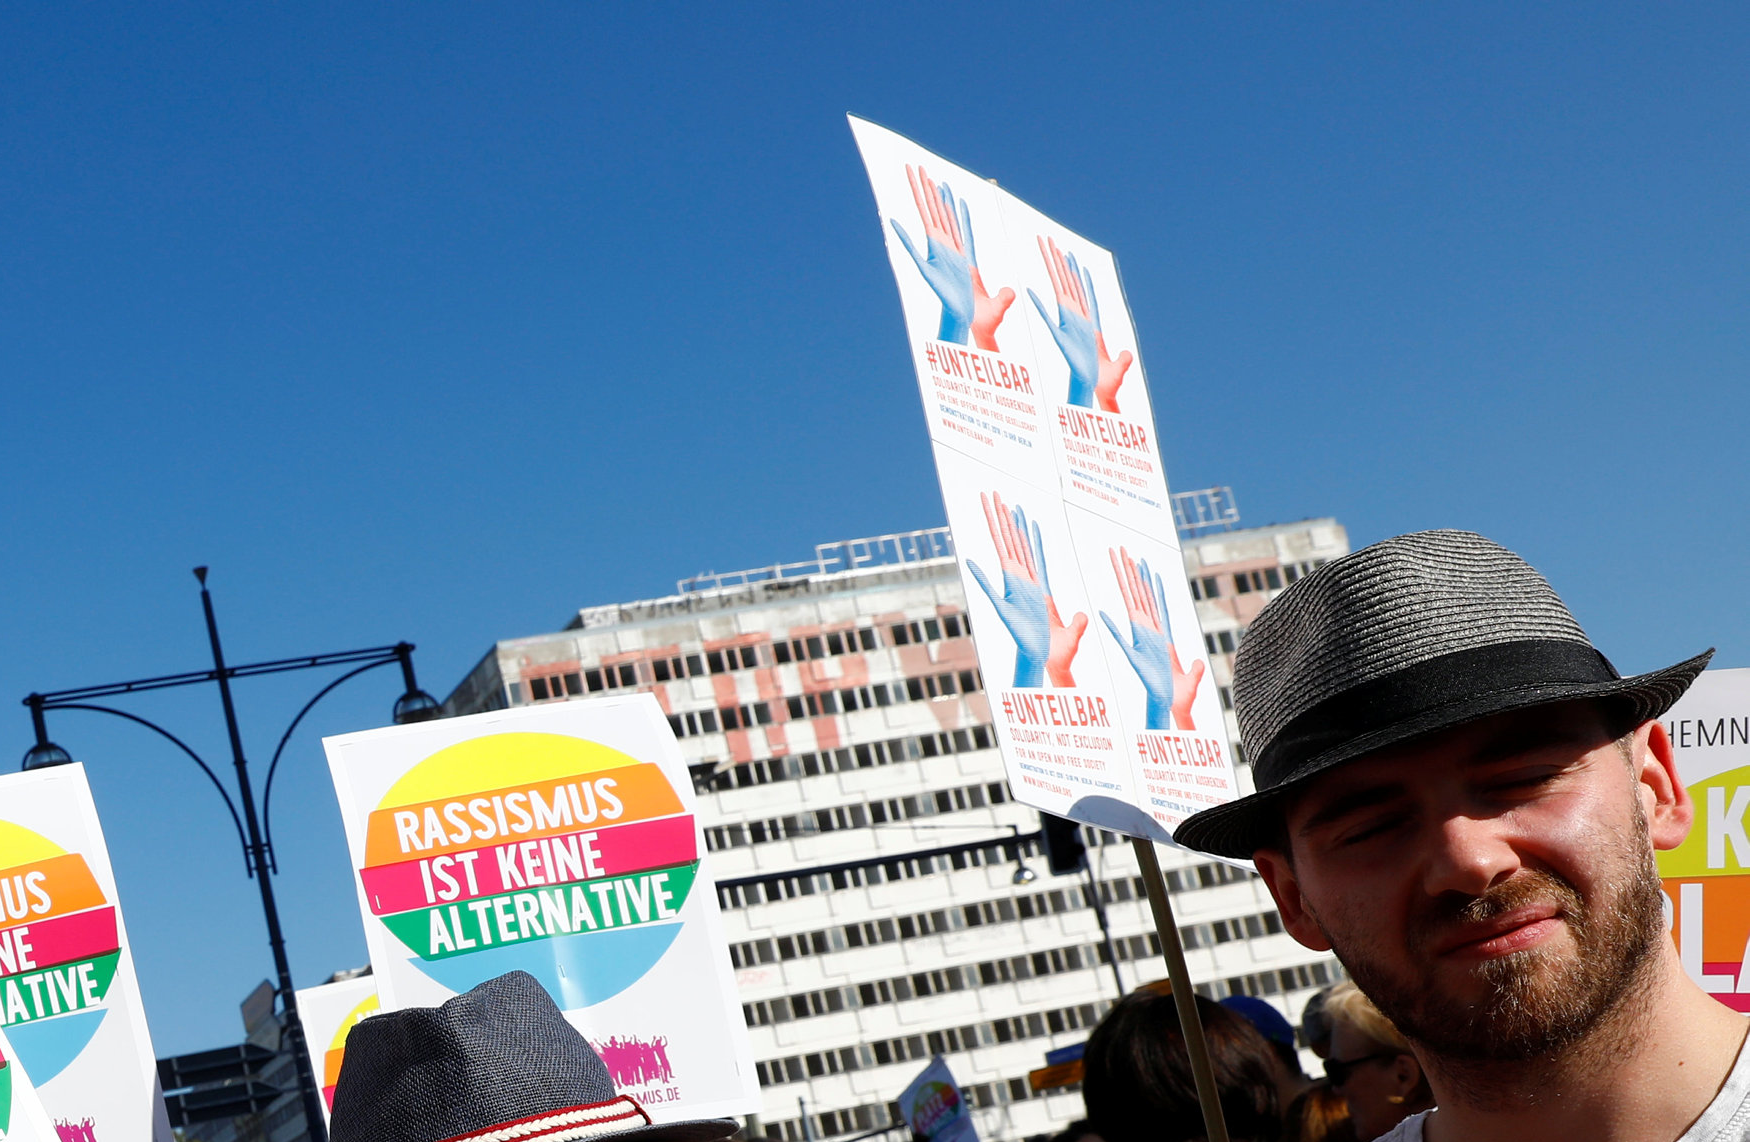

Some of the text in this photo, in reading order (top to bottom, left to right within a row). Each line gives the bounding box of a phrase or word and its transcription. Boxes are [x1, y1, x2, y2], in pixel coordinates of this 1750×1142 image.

[926, 341, 1034, 396] #UNTEILBAR
[1058, 406, 1150, 454] #UNTEILBAR
[1002, 692, 1111, 728] #UNTEILBAR
[1056, 732, 1071, 747] NOT
[1136, 734, 1226, 768] #UNTEILBAR
[394, 776, 624, 854] RASSISMUS
[1706, 785, 1750, 869] K
[419, 832, 606, 904] IST KEINE
[429, 872, 677, 956] ALTERNATIVE
[630, 1086, 681, 1105] MUS.DE
